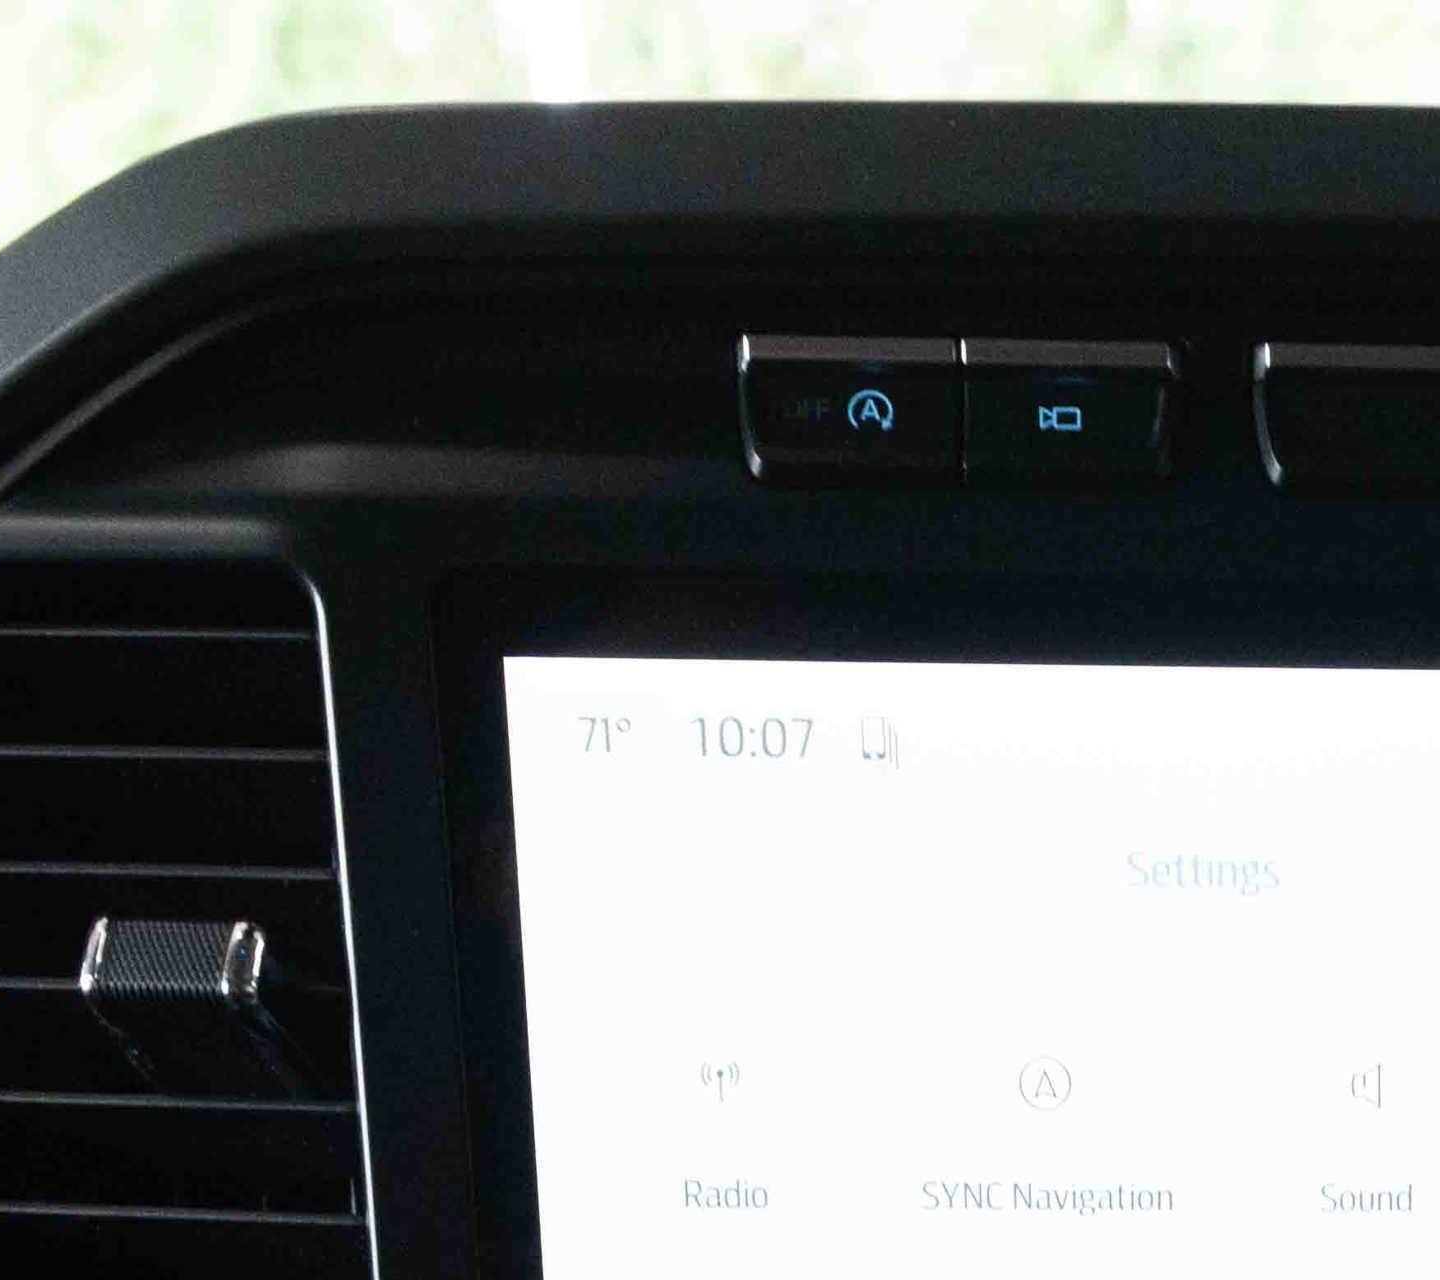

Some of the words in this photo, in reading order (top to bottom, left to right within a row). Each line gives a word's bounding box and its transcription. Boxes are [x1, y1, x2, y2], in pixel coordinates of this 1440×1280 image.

[694, 716, 815, 759] 10:07
[1127, 852, 1281, 897] Settings
[684, 1178, 769, 1210] Radio
[922, 1181, 1003, 1211] SYNC
[1013, 1181, 1174, 1216] Navigation
[1320, 1182, 1413, 1213] Sound
